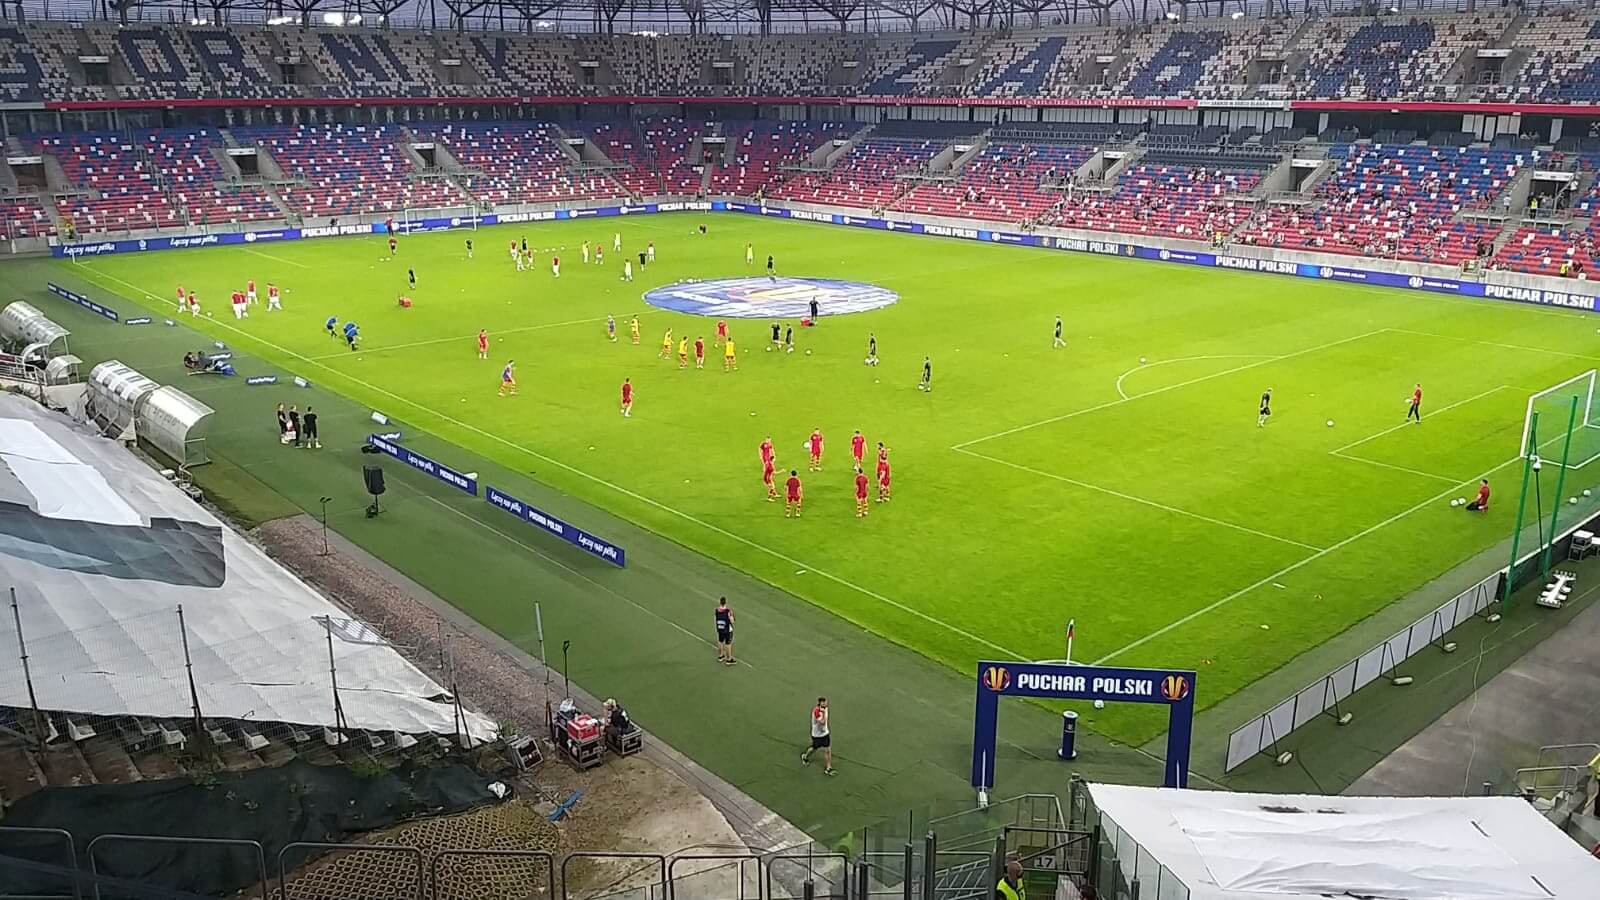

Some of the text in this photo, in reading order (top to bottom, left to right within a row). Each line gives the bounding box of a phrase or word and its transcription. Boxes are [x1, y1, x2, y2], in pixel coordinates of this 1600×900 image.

[301, 224, 372, 238] PUCHAR POLSKI
[1055, 238, 1119, 254] PUCHAR POLSKI
[1215, 255, 1297, 274] PUCHAR POLSKI
[1485, 285, 1595, 309] PUCHAR POLSKI
[594, 542, 603, 553] nas
[1017, 673, 1153, 695] PUCHAR POLSKI
[1036, 857, 1053, 868] 17
